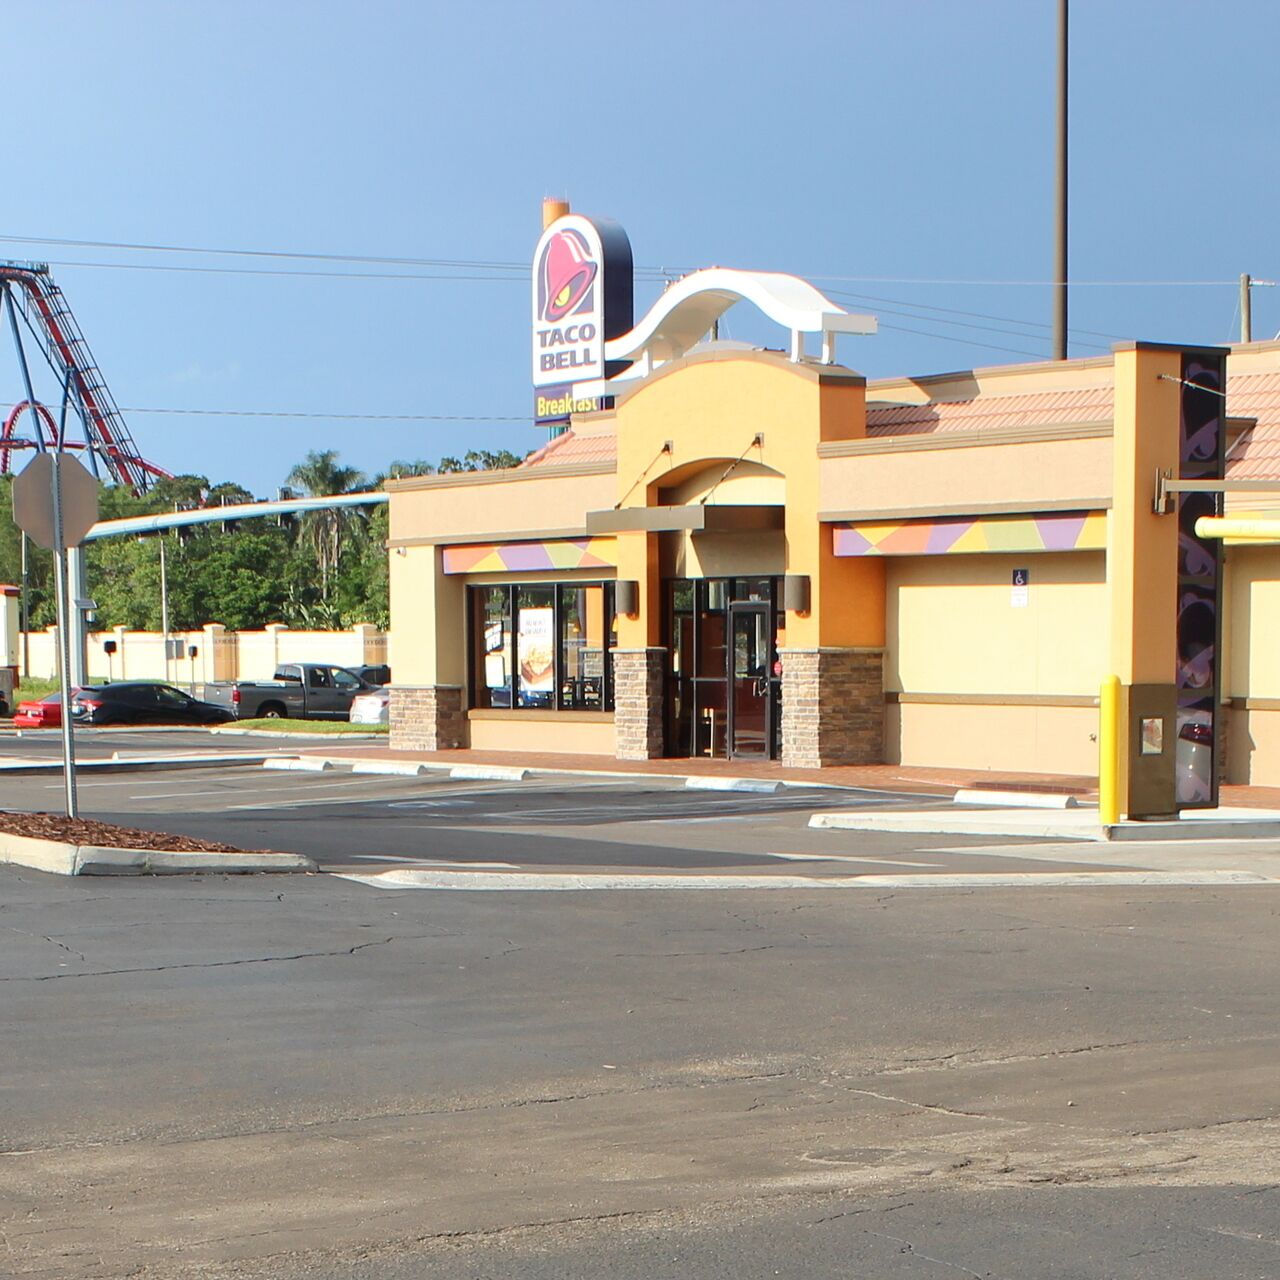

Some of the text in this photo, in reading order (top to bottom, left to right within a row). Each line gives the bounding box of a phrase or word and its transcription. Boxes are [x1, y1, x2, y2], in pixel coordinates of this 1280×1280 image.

[537, 323, 596, 348] TACO
[540, 348, 597, 372] BELL
[537, 392, 597, 417] Breakfast
